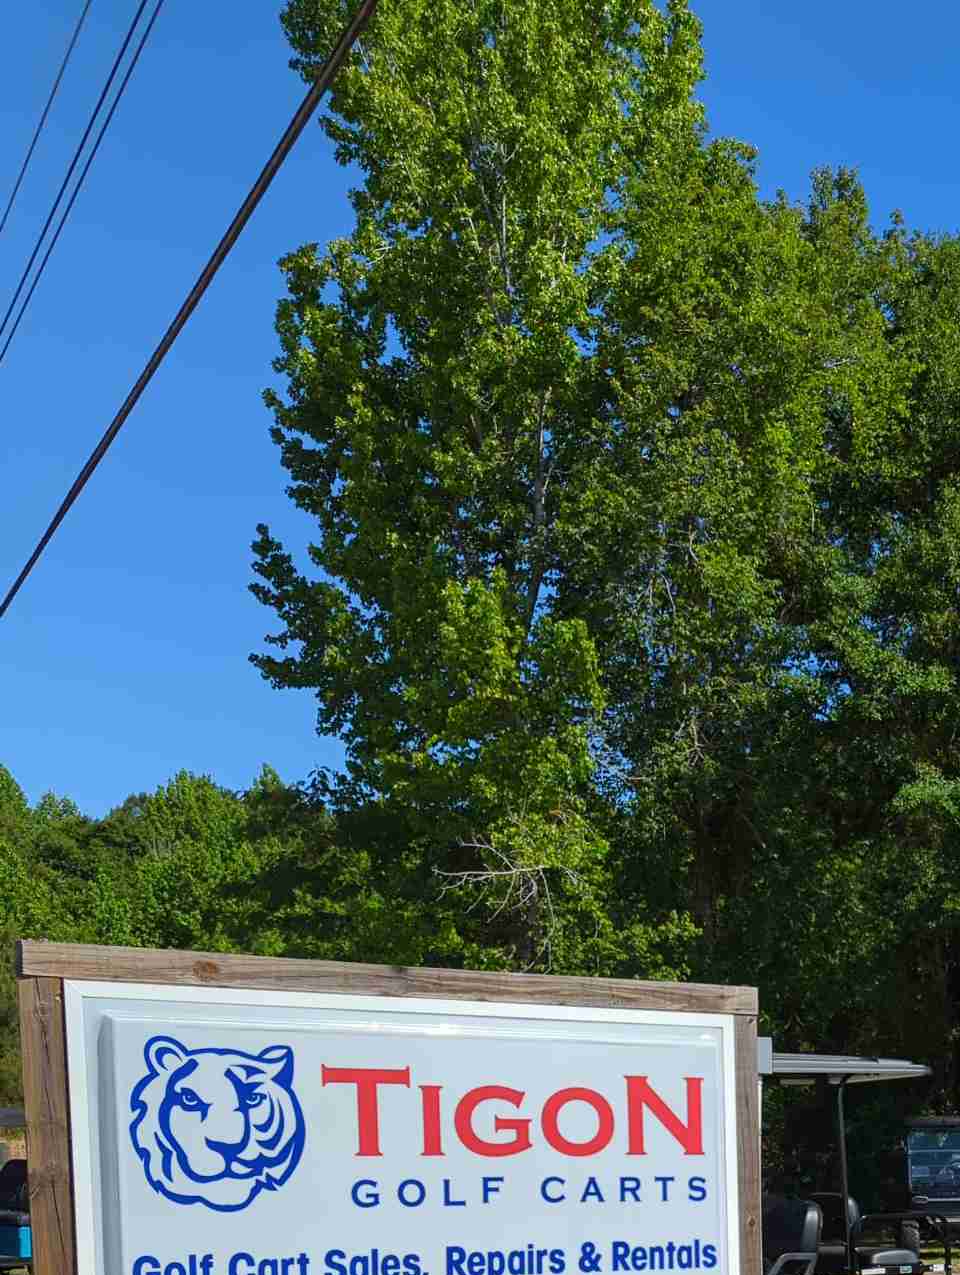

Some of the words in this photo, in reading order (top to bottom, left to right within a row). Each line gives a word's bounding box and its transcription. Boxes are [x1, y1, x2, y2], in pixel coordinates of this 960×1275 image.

[321, 1065, 706, 1158] TIGON
[351, 1176, 505, 1209] GOLF
[540, 1175, 708, 1204] CARTS
[578, 1241, 602, 1273] &
[611, 1239, 718, 1272] Rentals
